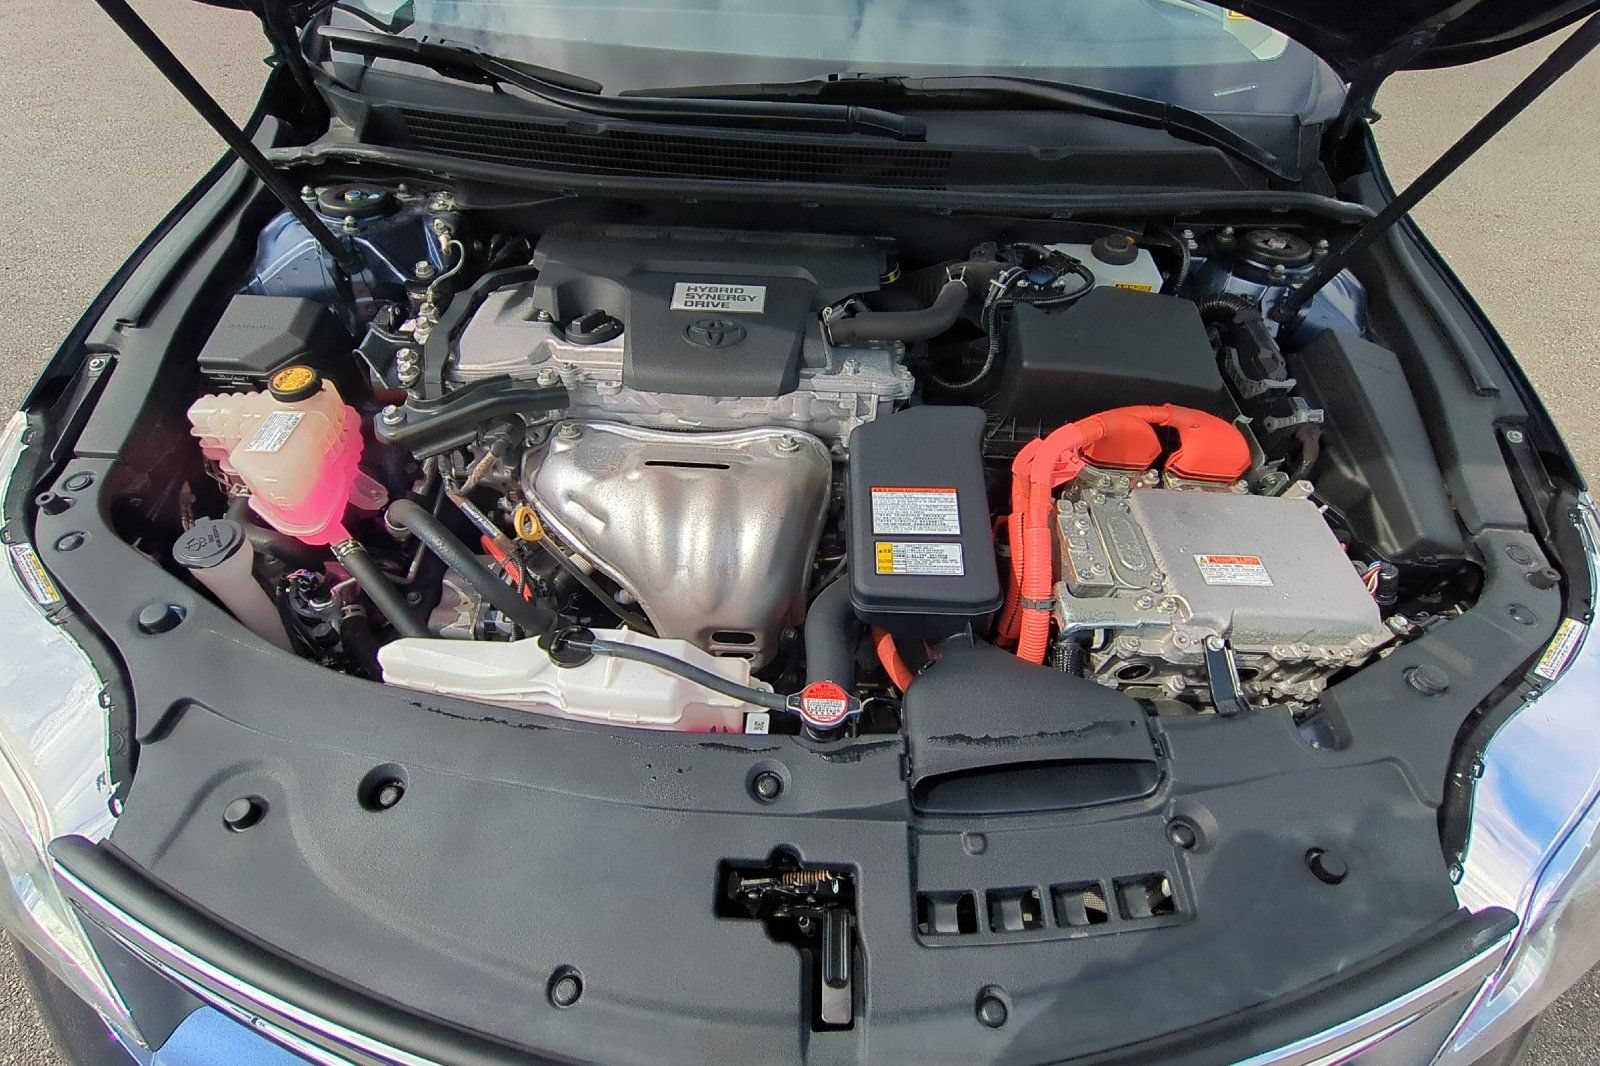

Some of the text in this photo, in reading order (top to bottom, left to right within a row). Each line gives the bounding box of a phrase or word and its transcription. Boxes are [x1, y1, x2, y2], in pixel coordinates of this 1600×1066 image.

[686, 286, 744, 294] HYBRID
[685, 293, 757, 302] SYNERGY
[684, 300, 730, 308] DRIVE
